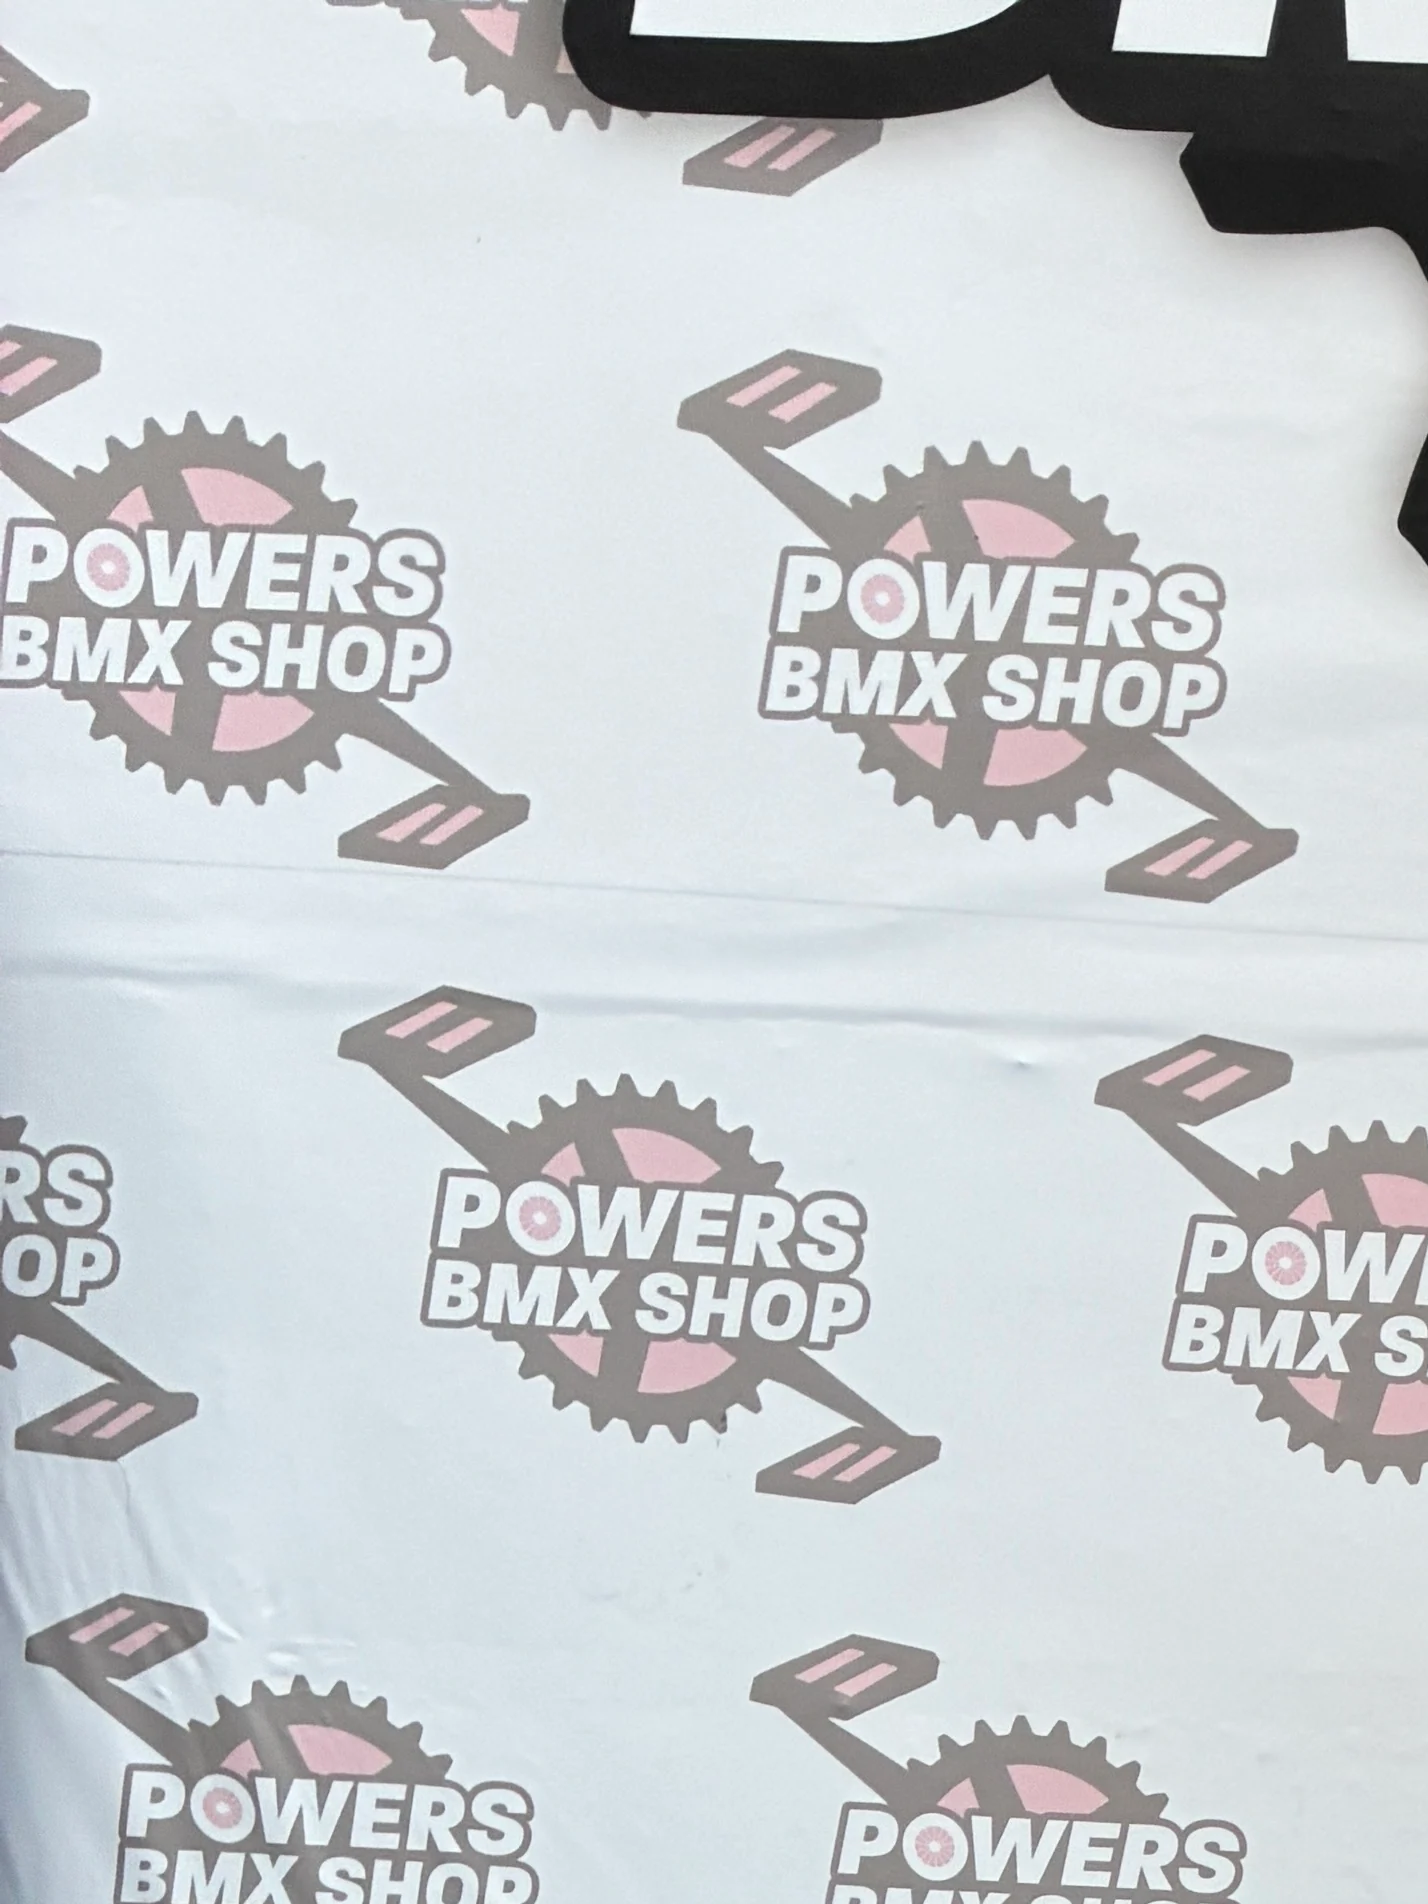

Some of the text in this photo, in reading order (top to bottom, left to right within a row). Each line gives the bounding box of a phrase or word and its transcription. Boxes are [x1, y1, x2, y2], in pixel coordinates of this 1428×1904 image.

[8, 527, 436, 616] POWERS
[783, 555, 1214, 652] POWERS
[0, 614, 446, 695] BMX SHOP
[770, 648, 1221, 729] BMX SHOP
[441, 1177, 865, 1271] POWERS
[430, 1260, 867, 1344] BMX SHOP
[1170, 1304, 1361, 1373] BMX
[128, 1770, 530, 1856] POWERS
[838, 1808, 1238, 1893] POWERS
